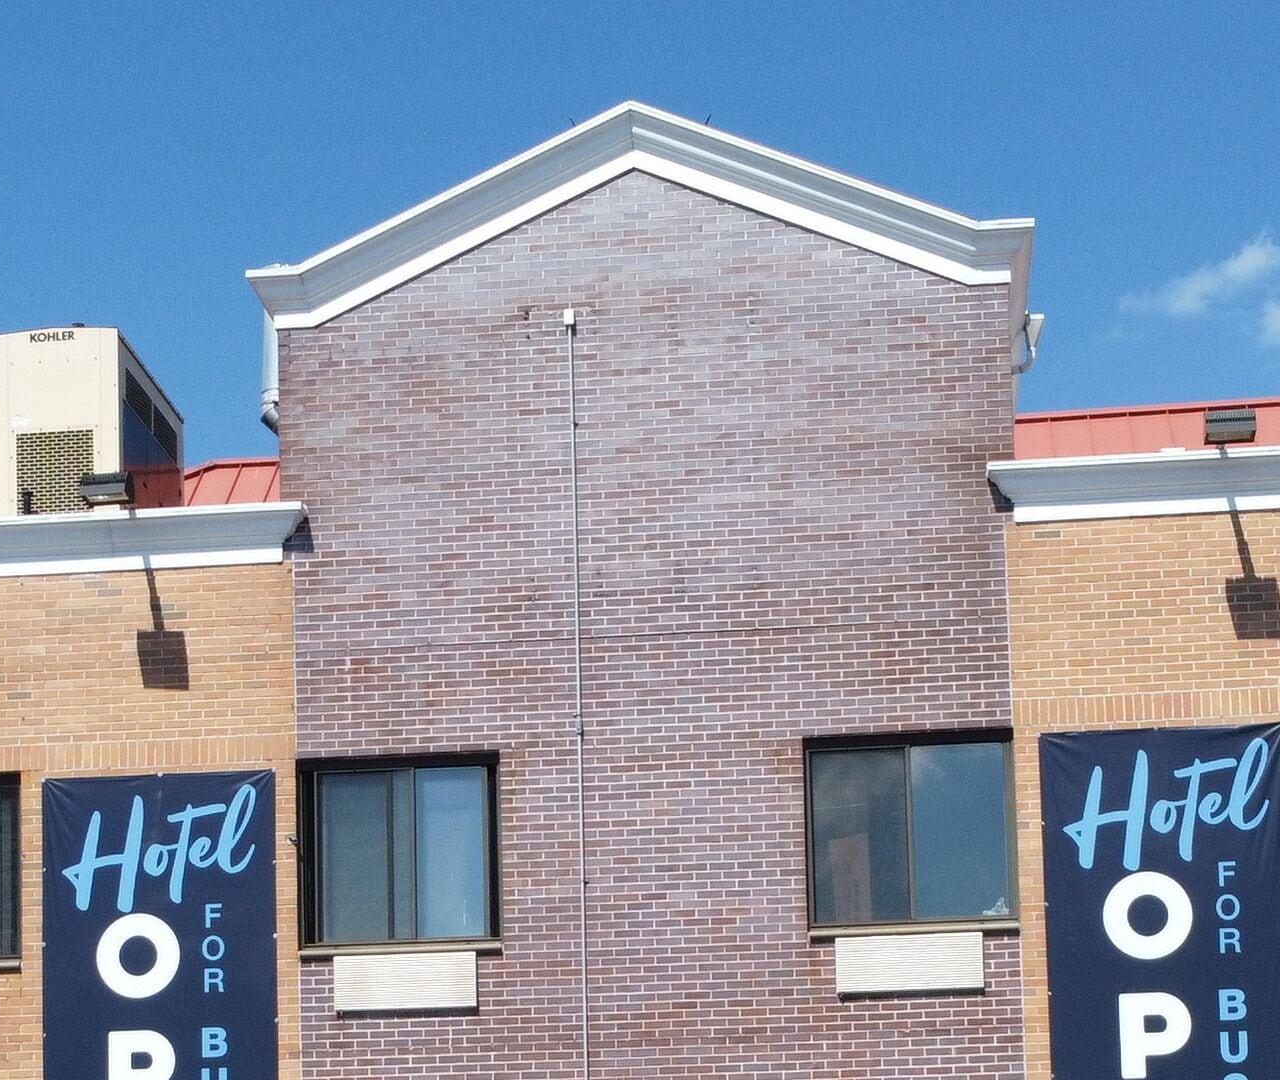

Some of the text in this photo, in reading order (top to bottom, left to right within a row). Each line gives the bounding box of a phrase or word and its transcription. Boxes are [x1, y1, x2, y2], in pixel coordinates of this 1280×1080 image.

[29, 330, 75, 343] KOHLER
[62, 784, 256, 912] Hotel
[1063, 737, 1269, 871] Hotel
[202, 904, 225, 993] FOR
[1215, 861, 1242, 954] FOR
